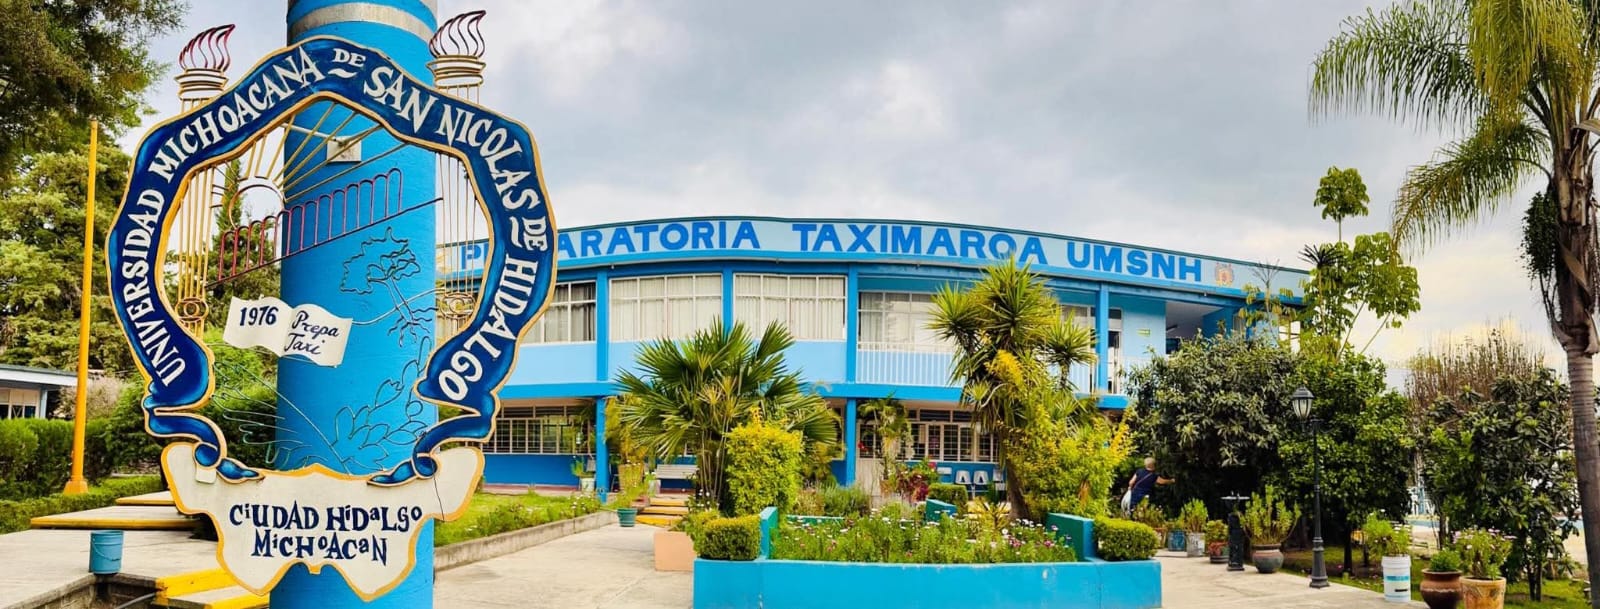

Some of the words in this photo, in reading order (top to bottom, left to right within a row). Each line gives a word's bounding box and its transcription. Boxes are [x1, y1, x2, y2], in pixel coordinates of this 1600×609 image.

[331, 48, 367, 69] DE
[148, 46, 326, 184] MICHOACANA
[363, 66, 439, 134] SAN
[435, 103, 541, 210] NICOLAS
[461, 221, 761, 270] PARATORIA
[792, 223, 1048, 265] TAXIMAROA
[1067, 240, 1202, 282] UMSNH
[521, 216, 549, 252] DE
[122, 188, 186, 387] UNIVERSIDAD
[240, 305, 279, 327] 1976
[283, 332, 326, 355] Taxi
[291, 310, 340, 340] Prepa
[438, 253, 539, 401] HIDALGO
